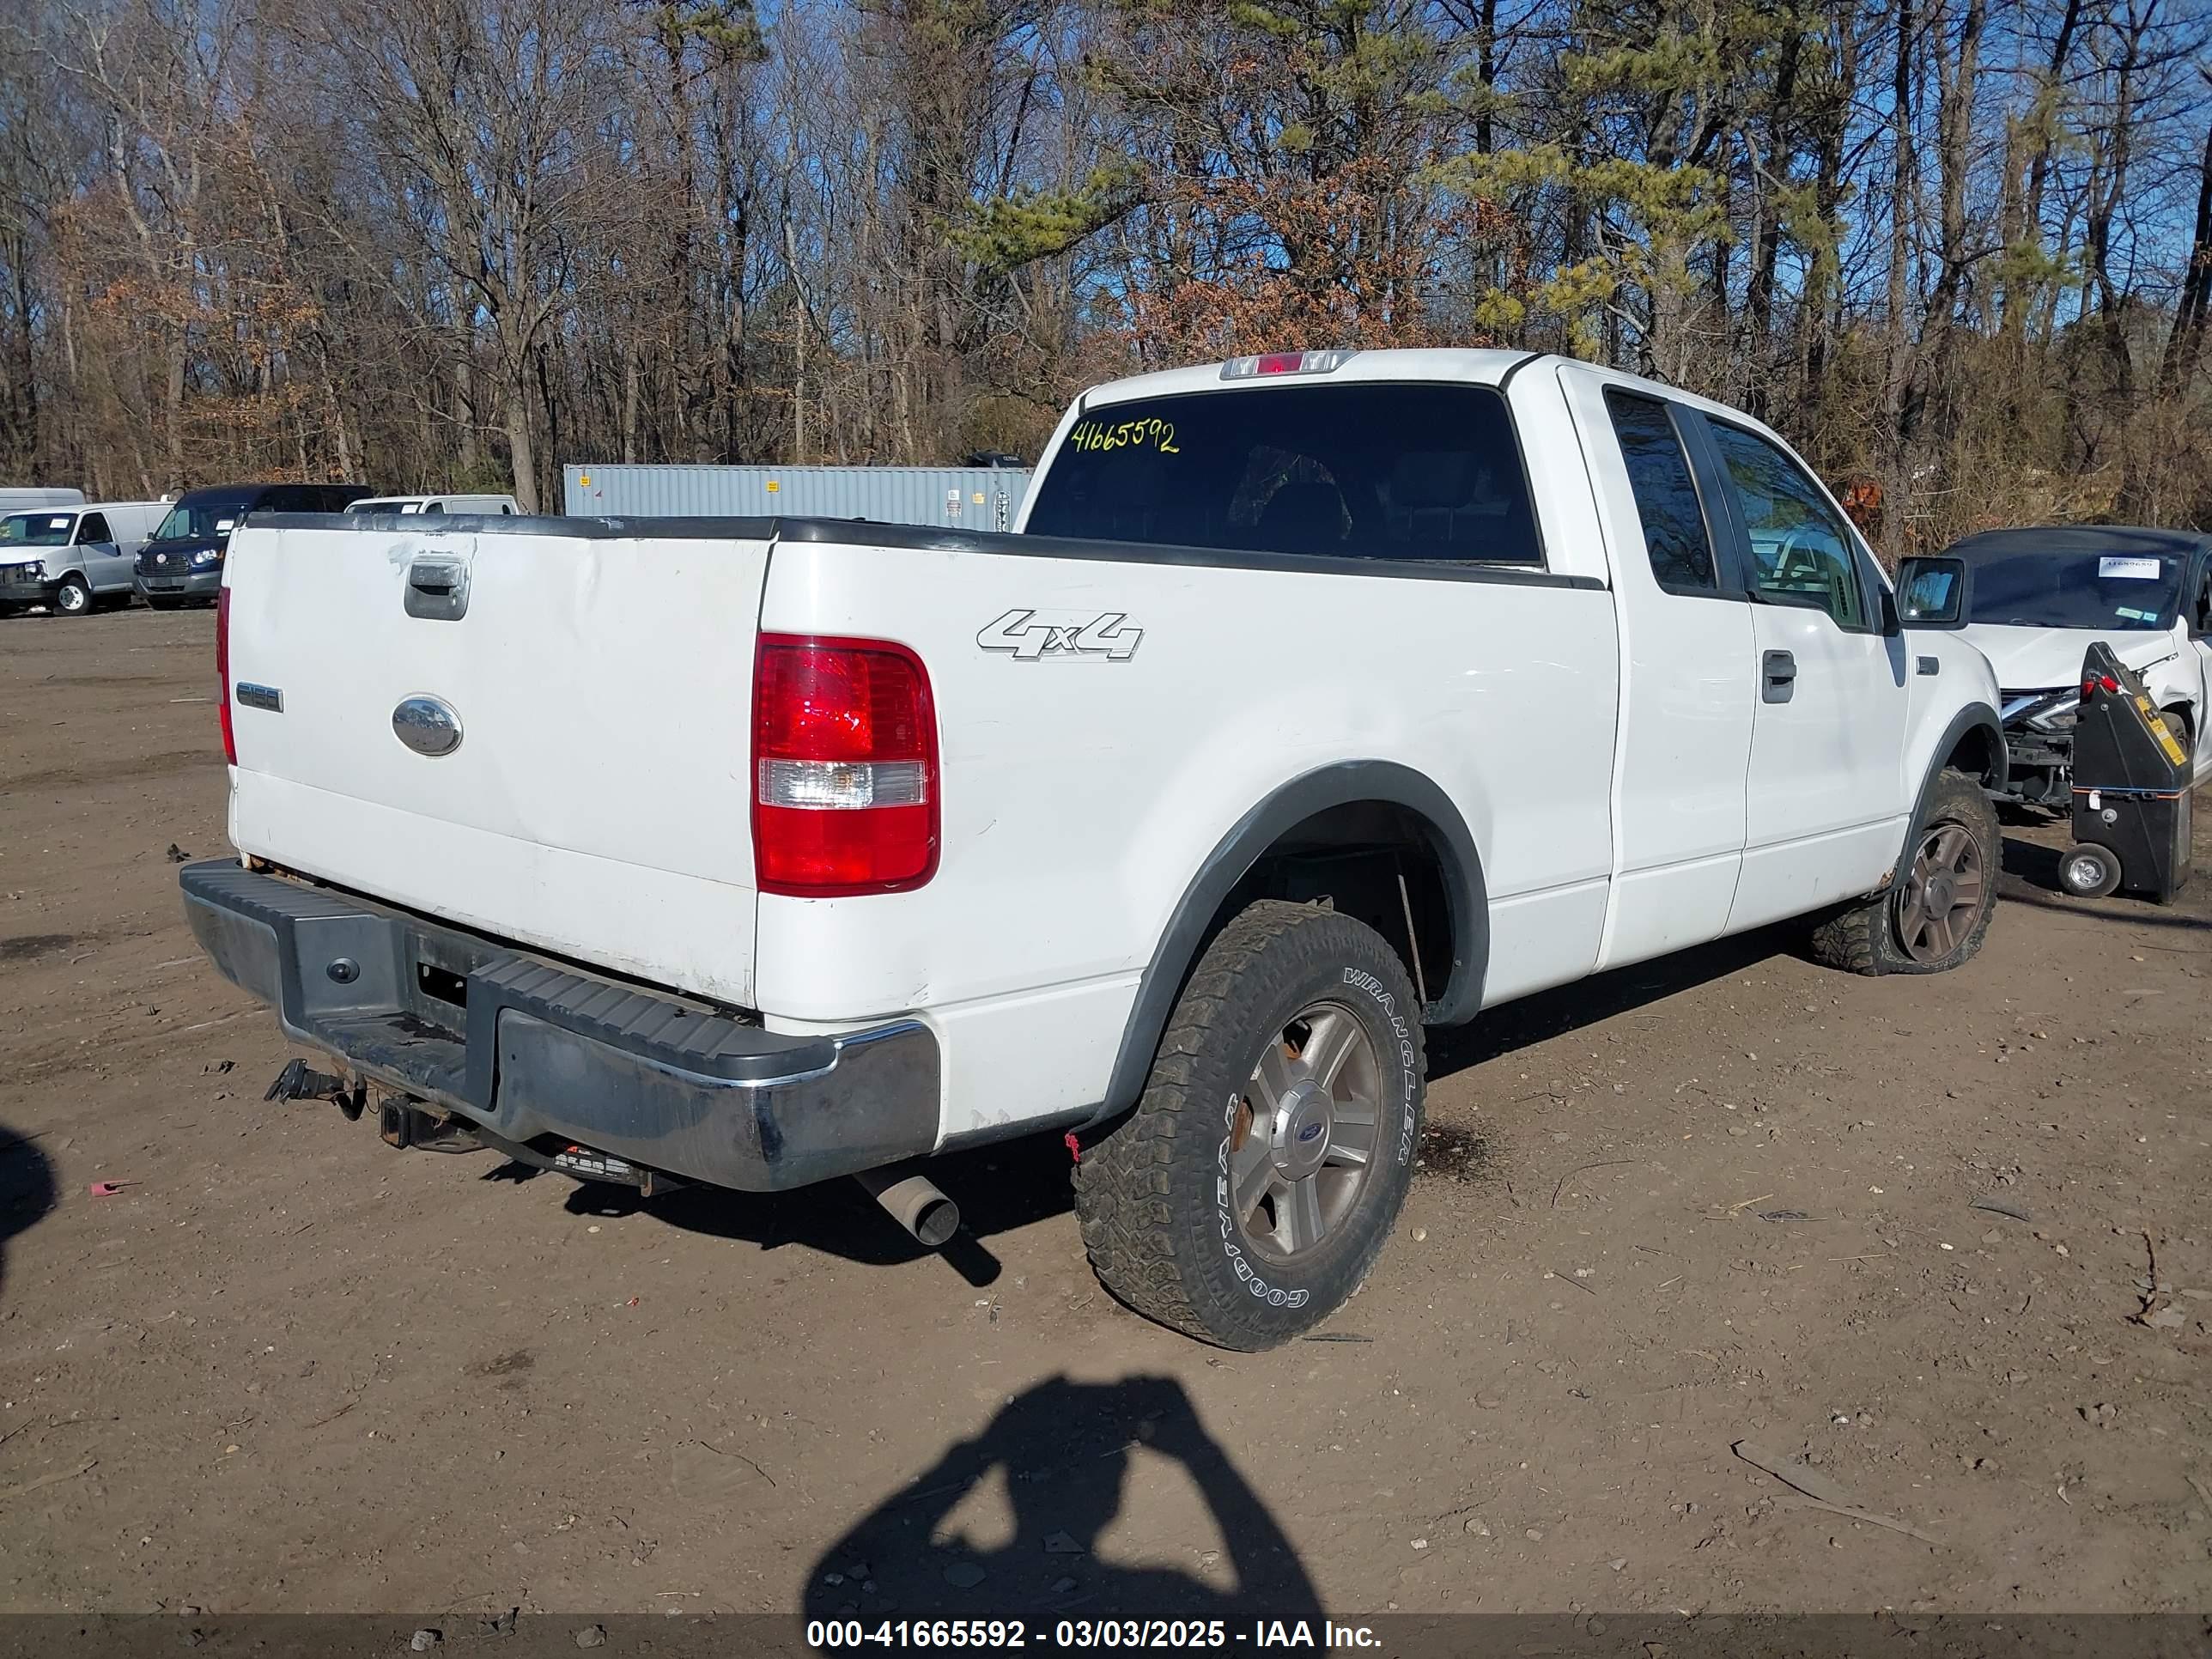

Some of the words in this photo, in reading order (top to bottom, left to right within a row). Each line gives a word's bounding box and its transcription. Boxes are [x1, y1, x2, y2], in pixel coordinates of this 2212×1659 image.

[1071, 417, 1180, 453] 41665592
[975, 608, 1146, 661] 4x4
[1343, 967, 1417, 1167] WRANGLER
[1216, 1092, 1310, 1309] GOODYEAR
